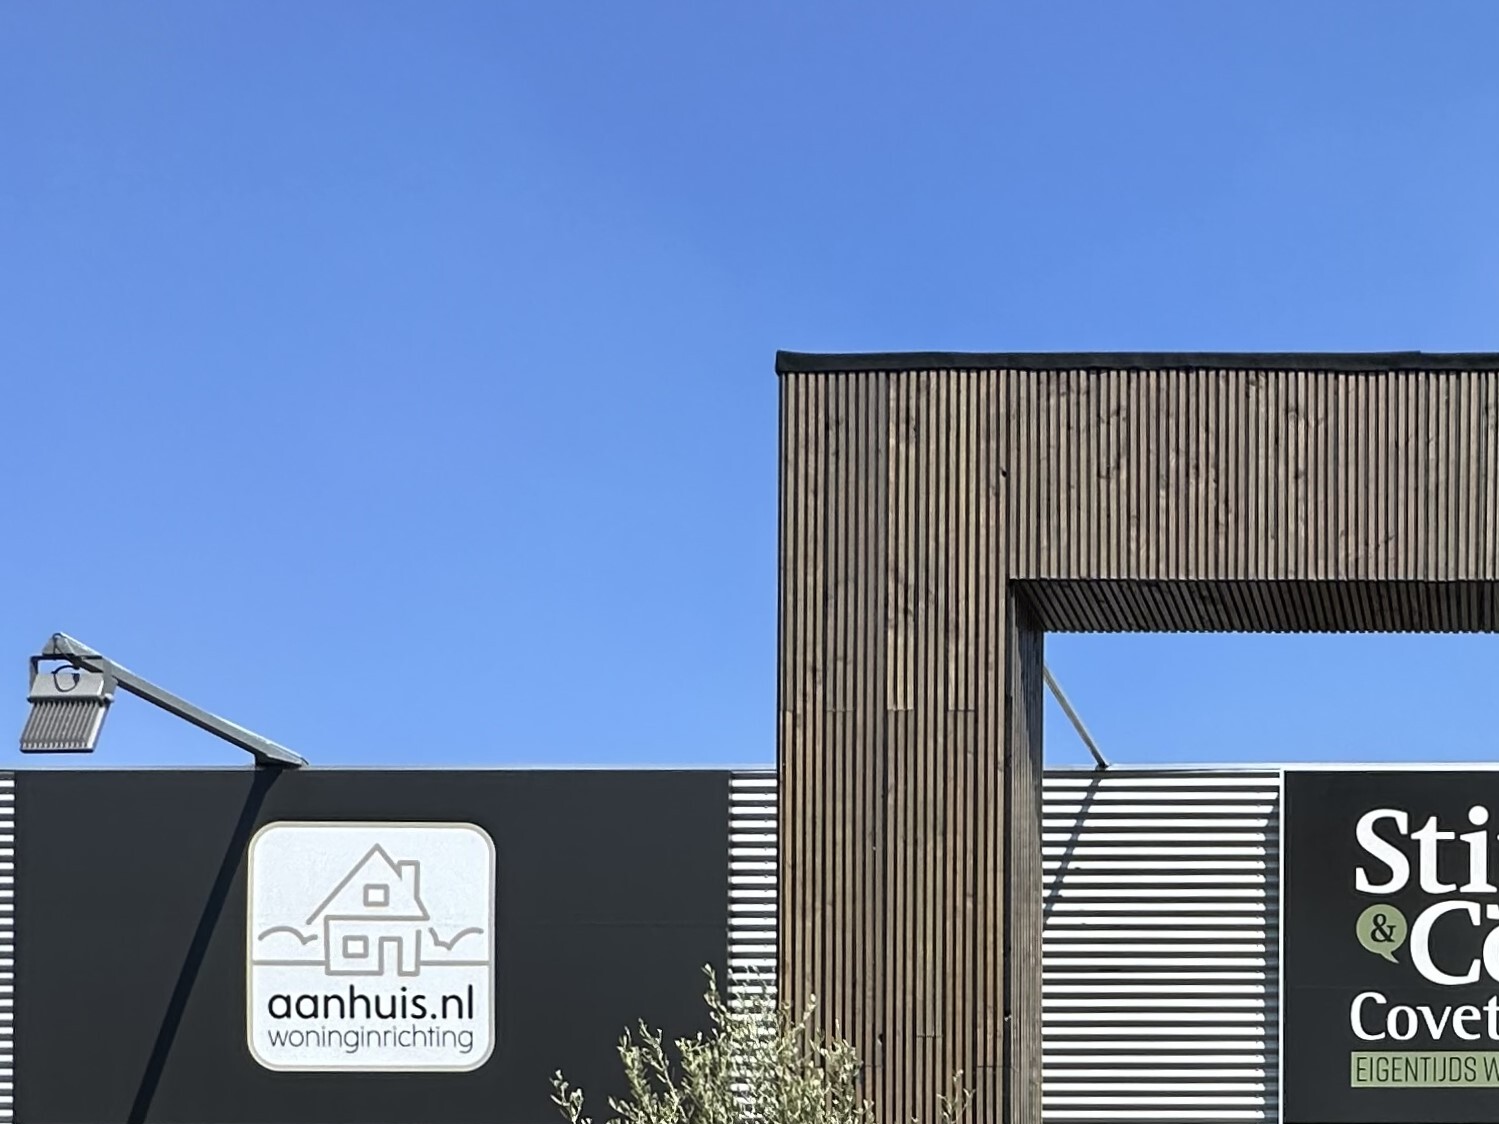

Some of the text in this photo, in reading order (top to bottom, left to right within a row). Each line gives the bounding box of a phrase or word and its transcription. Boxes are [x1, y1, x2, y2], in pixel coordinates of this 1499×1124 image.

[1369, 912, 1396, 943] &
[267, 984, 475, 1020] aanhuis.nl
[267, 1024, 474, 1055] woninginrichting
[1356, 1056, 1477, 1082] EIGENTIJDS
